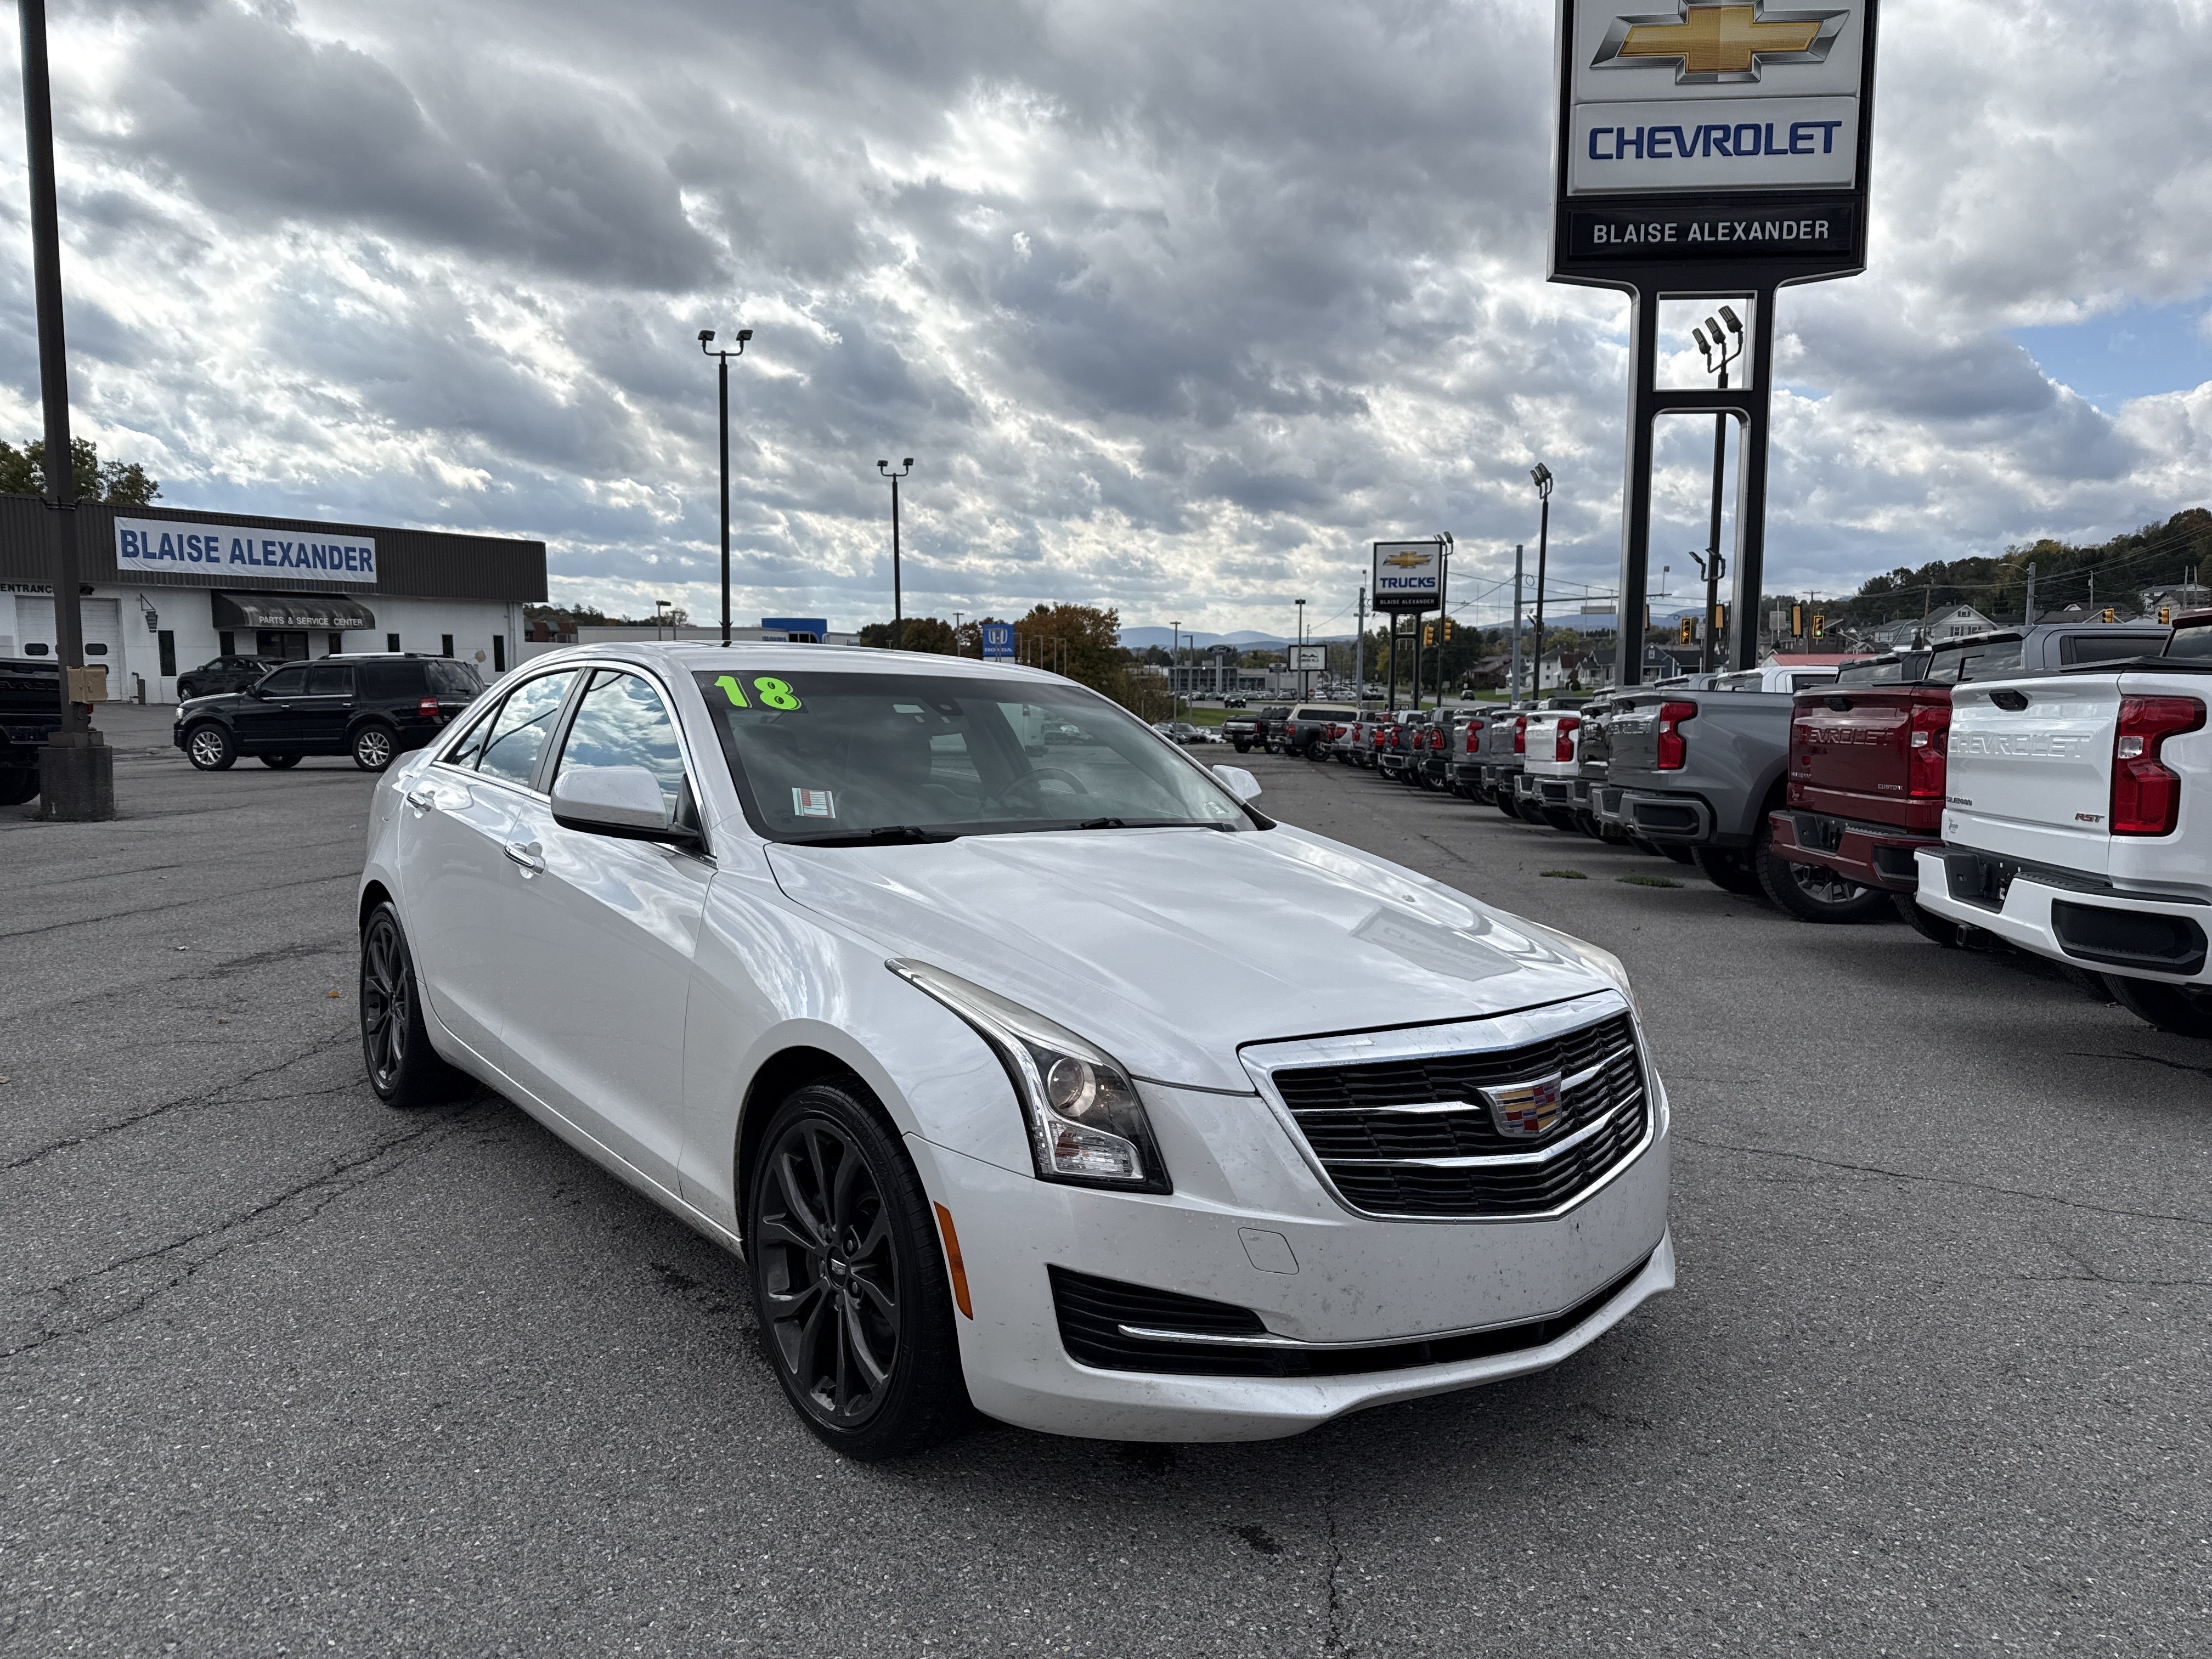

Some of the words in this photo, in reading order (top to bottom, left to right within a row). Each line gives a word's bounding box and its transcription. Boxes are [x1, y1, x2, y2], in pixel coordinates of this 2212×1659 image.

[1589, 121, 1842, 160] CHEVROLET
[1594, 223, 1677, 244] BLAISE
[1687, 220, 1829, 241] ALEXANDER
[120, 529, 219, 563] BLAISE
[229, 538, 374, 572] ALEXANDER
[0, 583, 52, 593] ENTRANC
[1380, 577, 1436, 588] TRUCKS
[259, 616, 284, 624] PARTS
[296, 617, 329, 625] SERVICE
[714, 676, 802, 710] 18
[2075, 813, 2105, 822] RST
